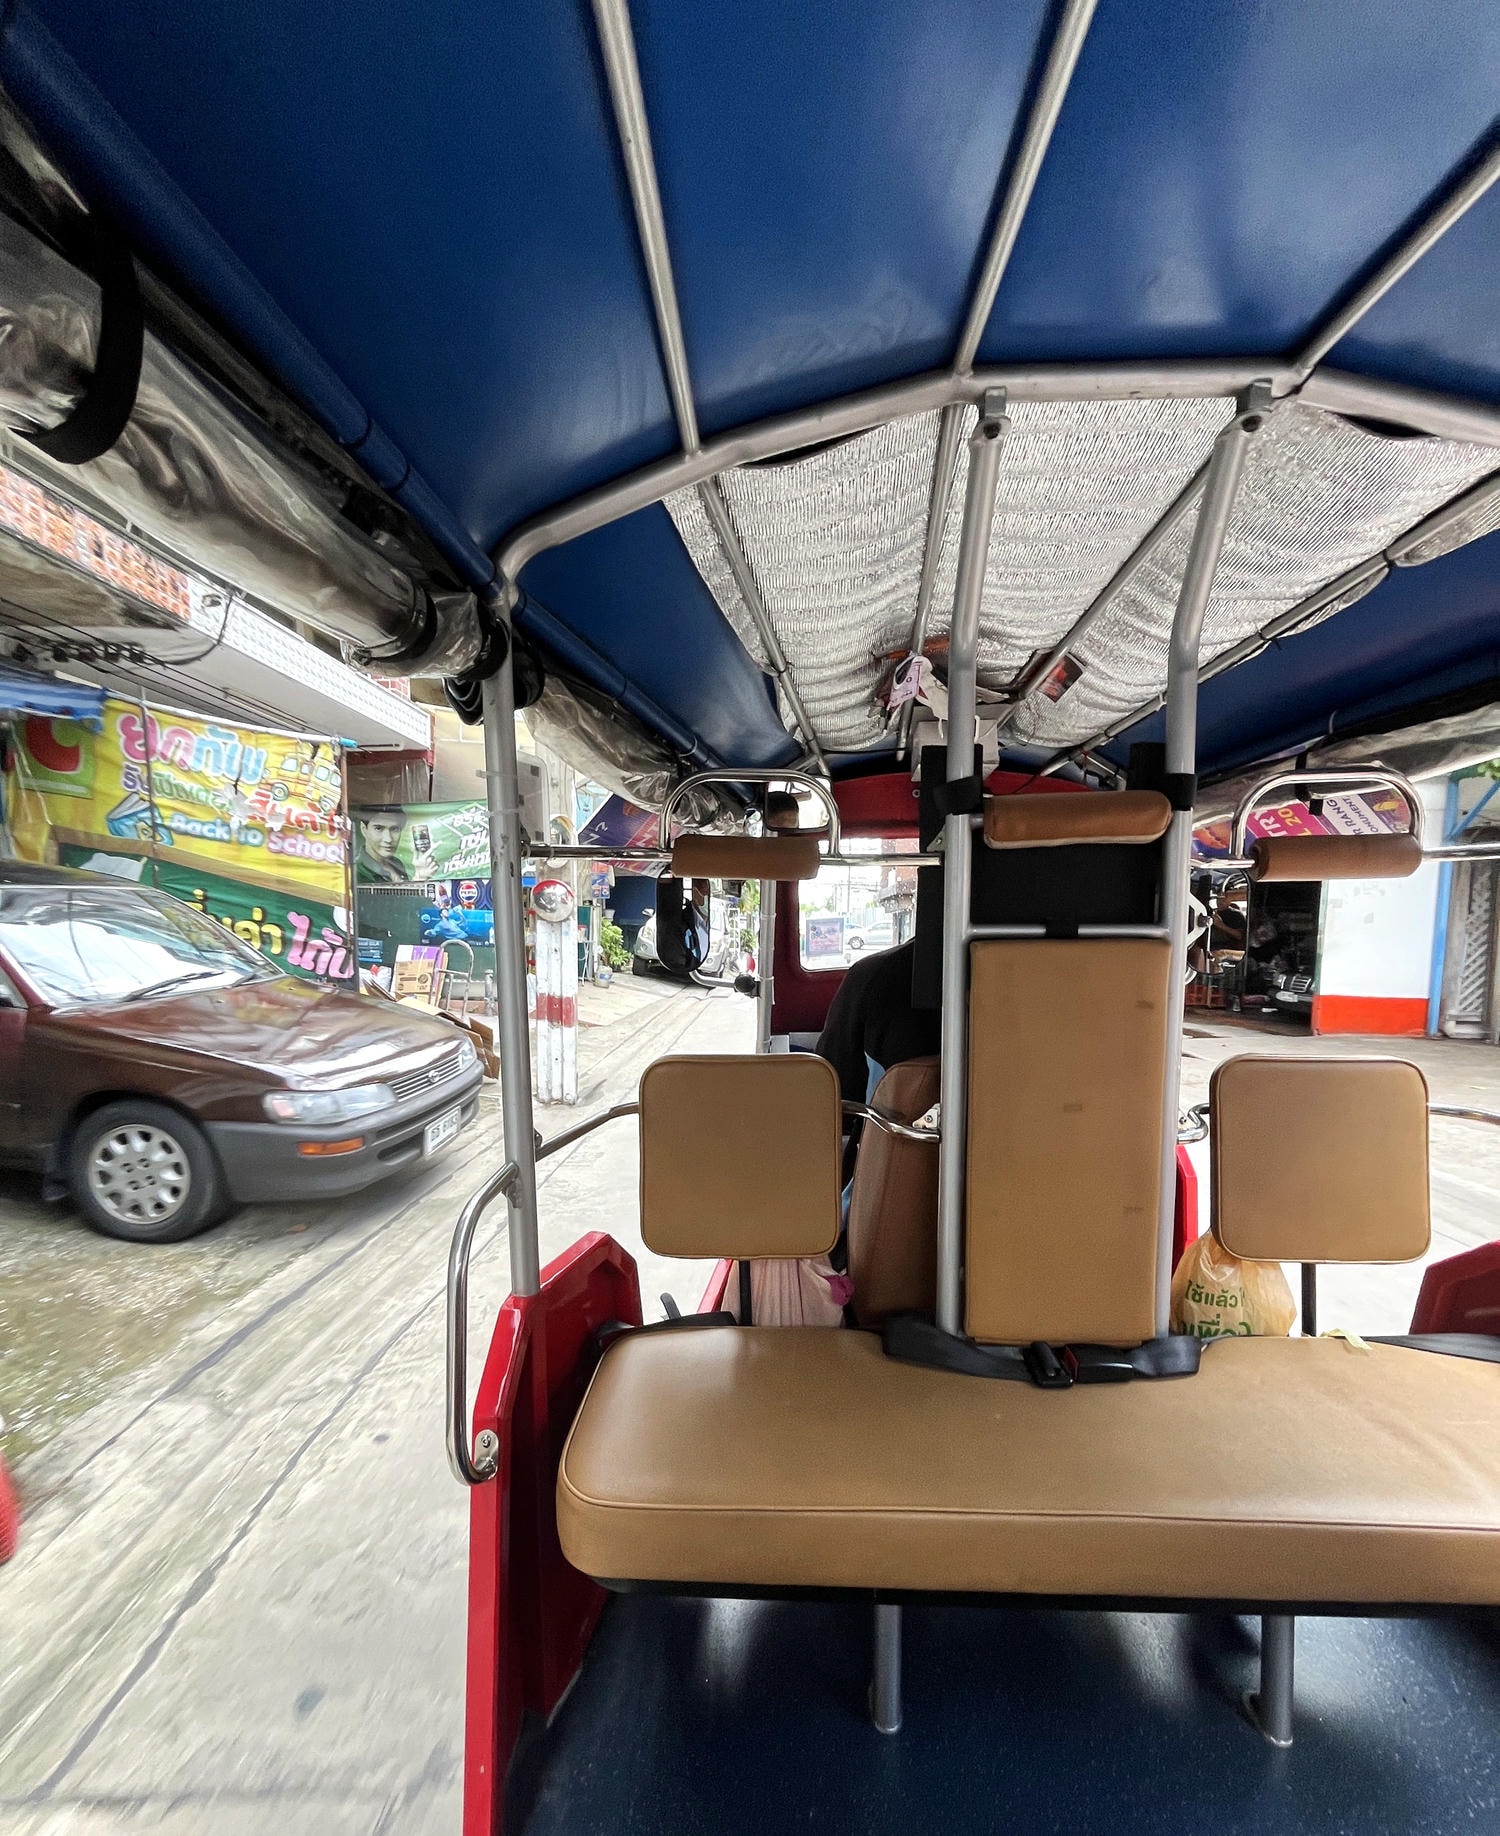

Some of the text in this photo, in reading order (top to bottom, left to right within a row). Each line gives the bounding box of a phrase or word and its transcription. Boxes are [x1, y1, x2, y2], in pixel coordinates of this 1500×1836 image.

[170, 812, 231, 842] Back
[1253, 807, 1288, 837] TRY
[1342, 797, 1379, 833] ONUMENT
